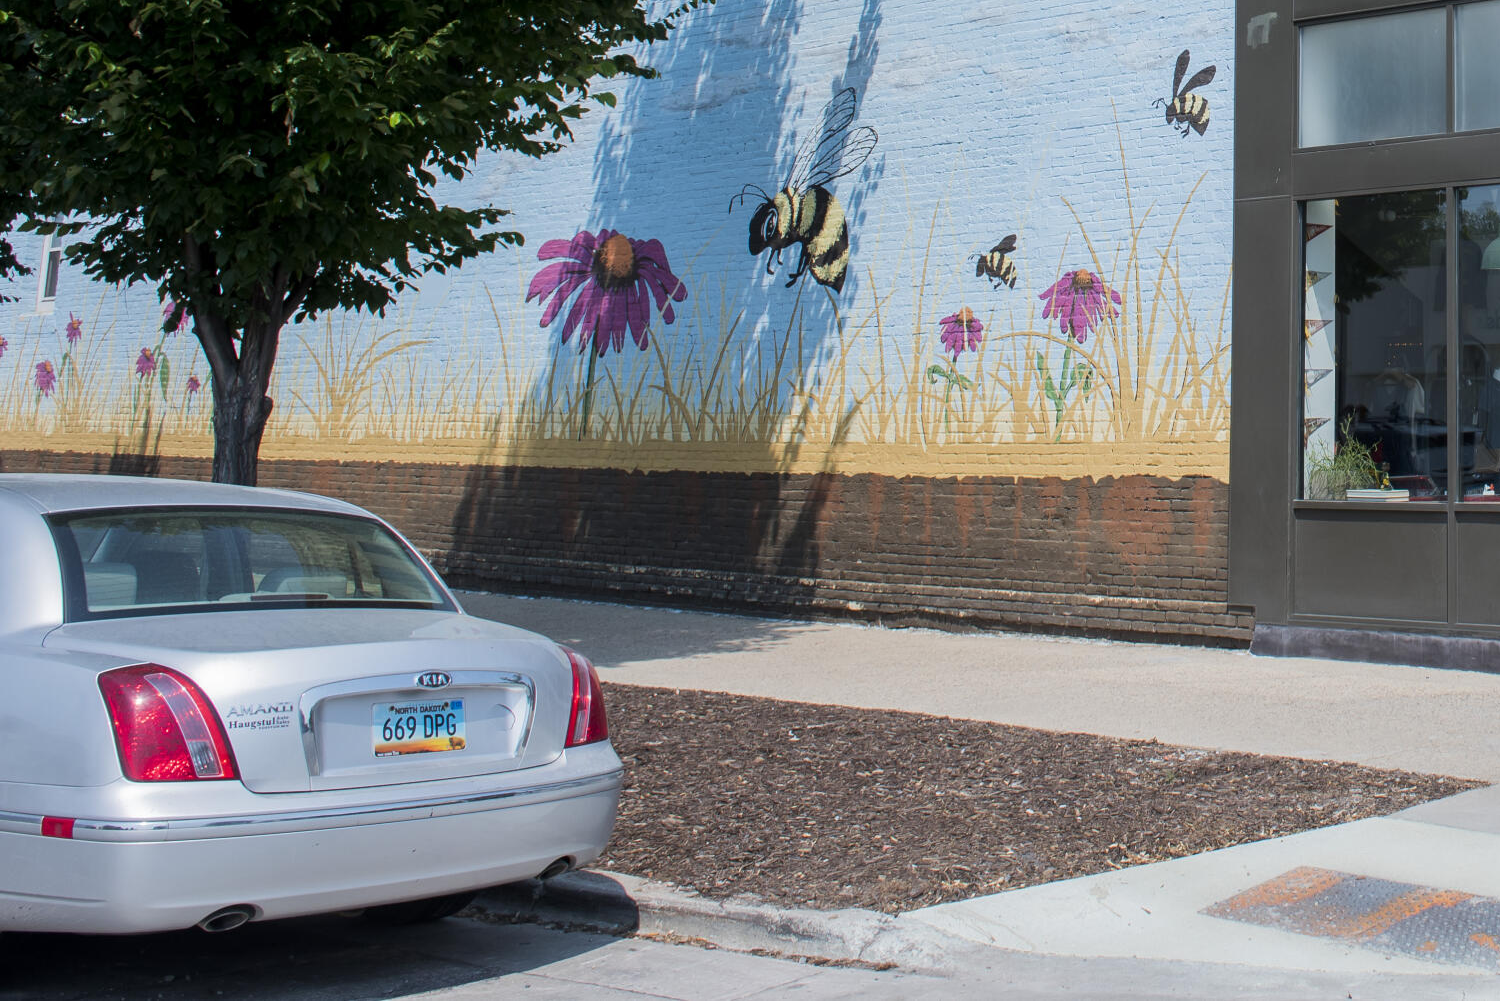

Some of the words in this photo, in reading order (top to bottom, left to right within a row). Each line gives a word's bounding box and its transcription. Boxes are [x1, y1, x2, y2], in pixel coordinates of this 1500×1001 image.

[422, 673, 448, 687] KIA
[394, 706, 418, 715] NORTH
[420, 704, 446, 713] DAKOTA
[383, 715, 417, 742] 669
[423, 712, 457, 739] DPG
